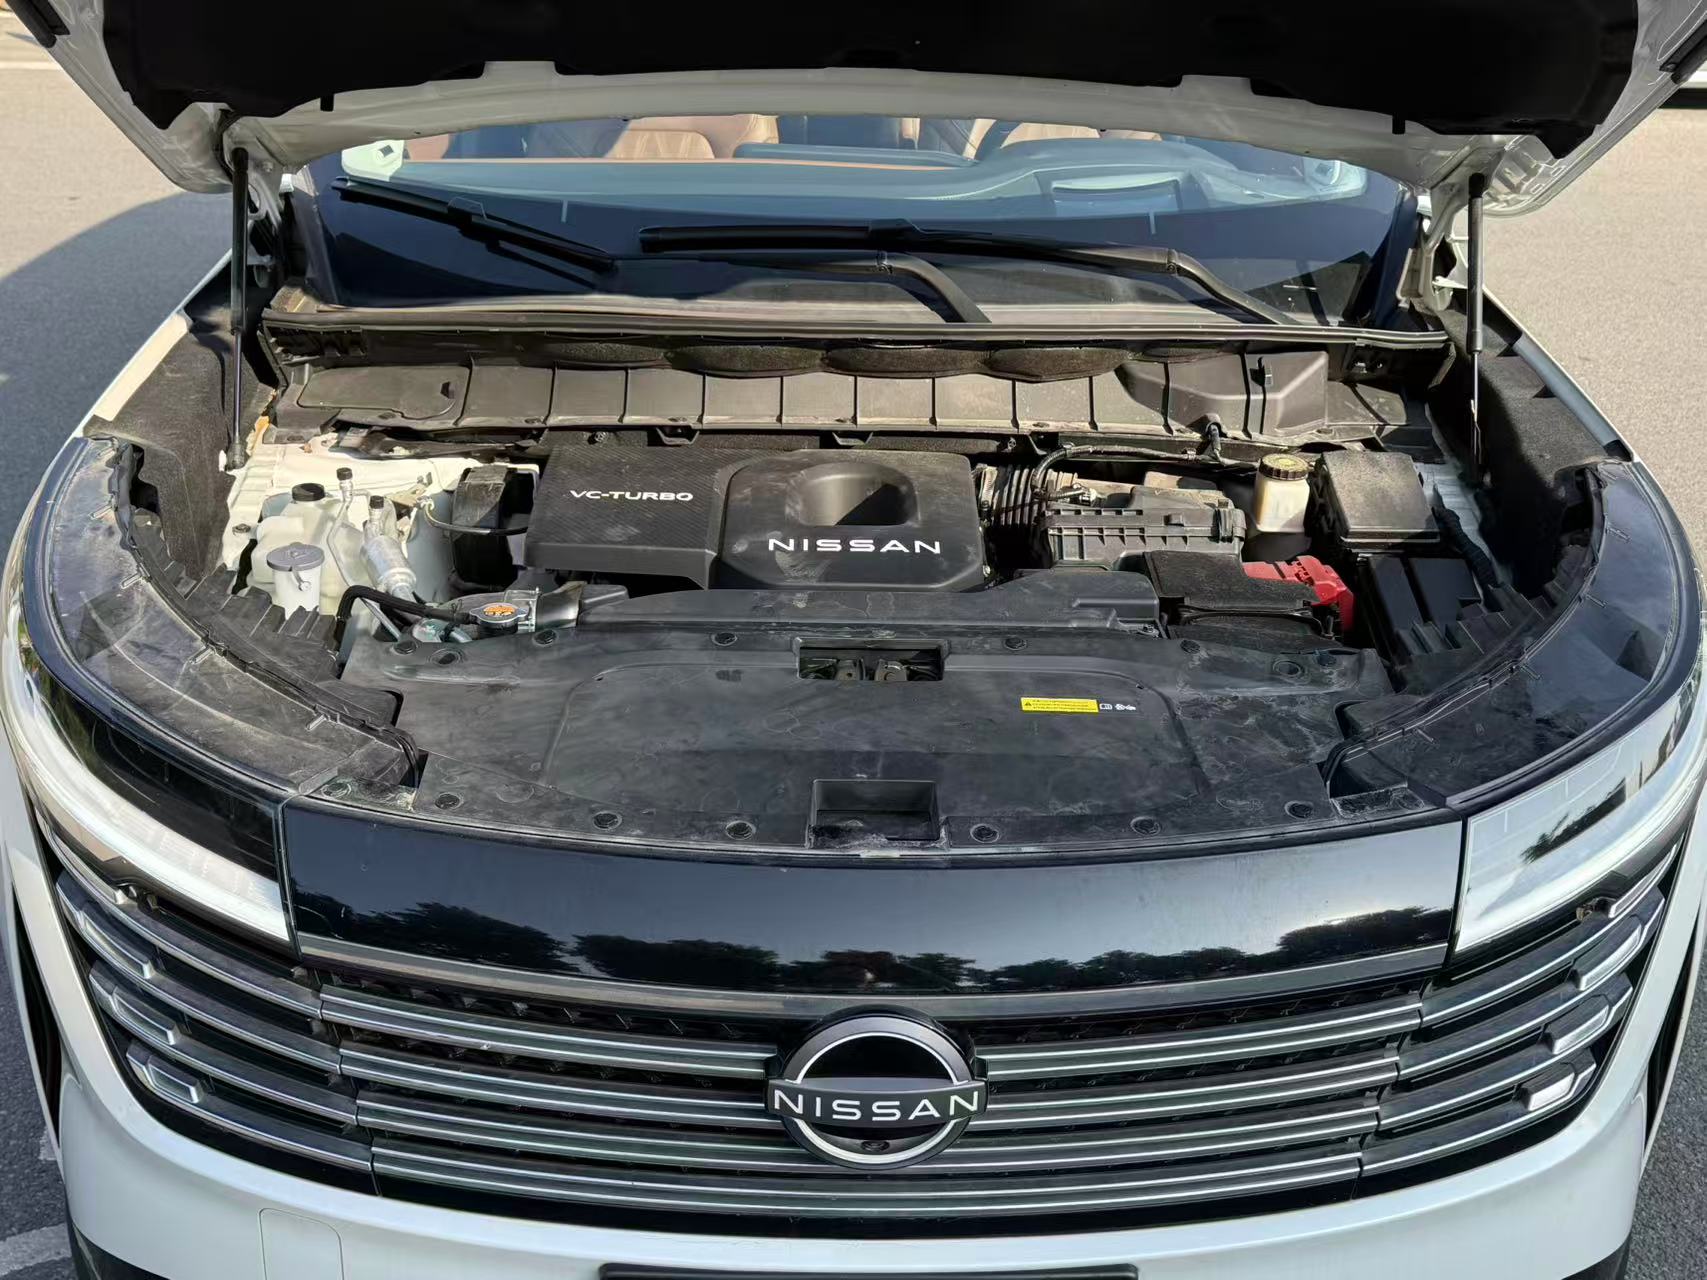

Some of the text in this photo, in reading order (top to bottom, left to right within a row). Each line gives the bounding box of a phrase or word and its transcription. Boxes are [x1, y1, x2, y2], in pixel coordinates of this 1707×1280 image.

[570, 489, 694, 502] VC-TURBO
[767, 537, 941, 555] NISSAN
[773, 1089, 979, 1122] NISSAN
